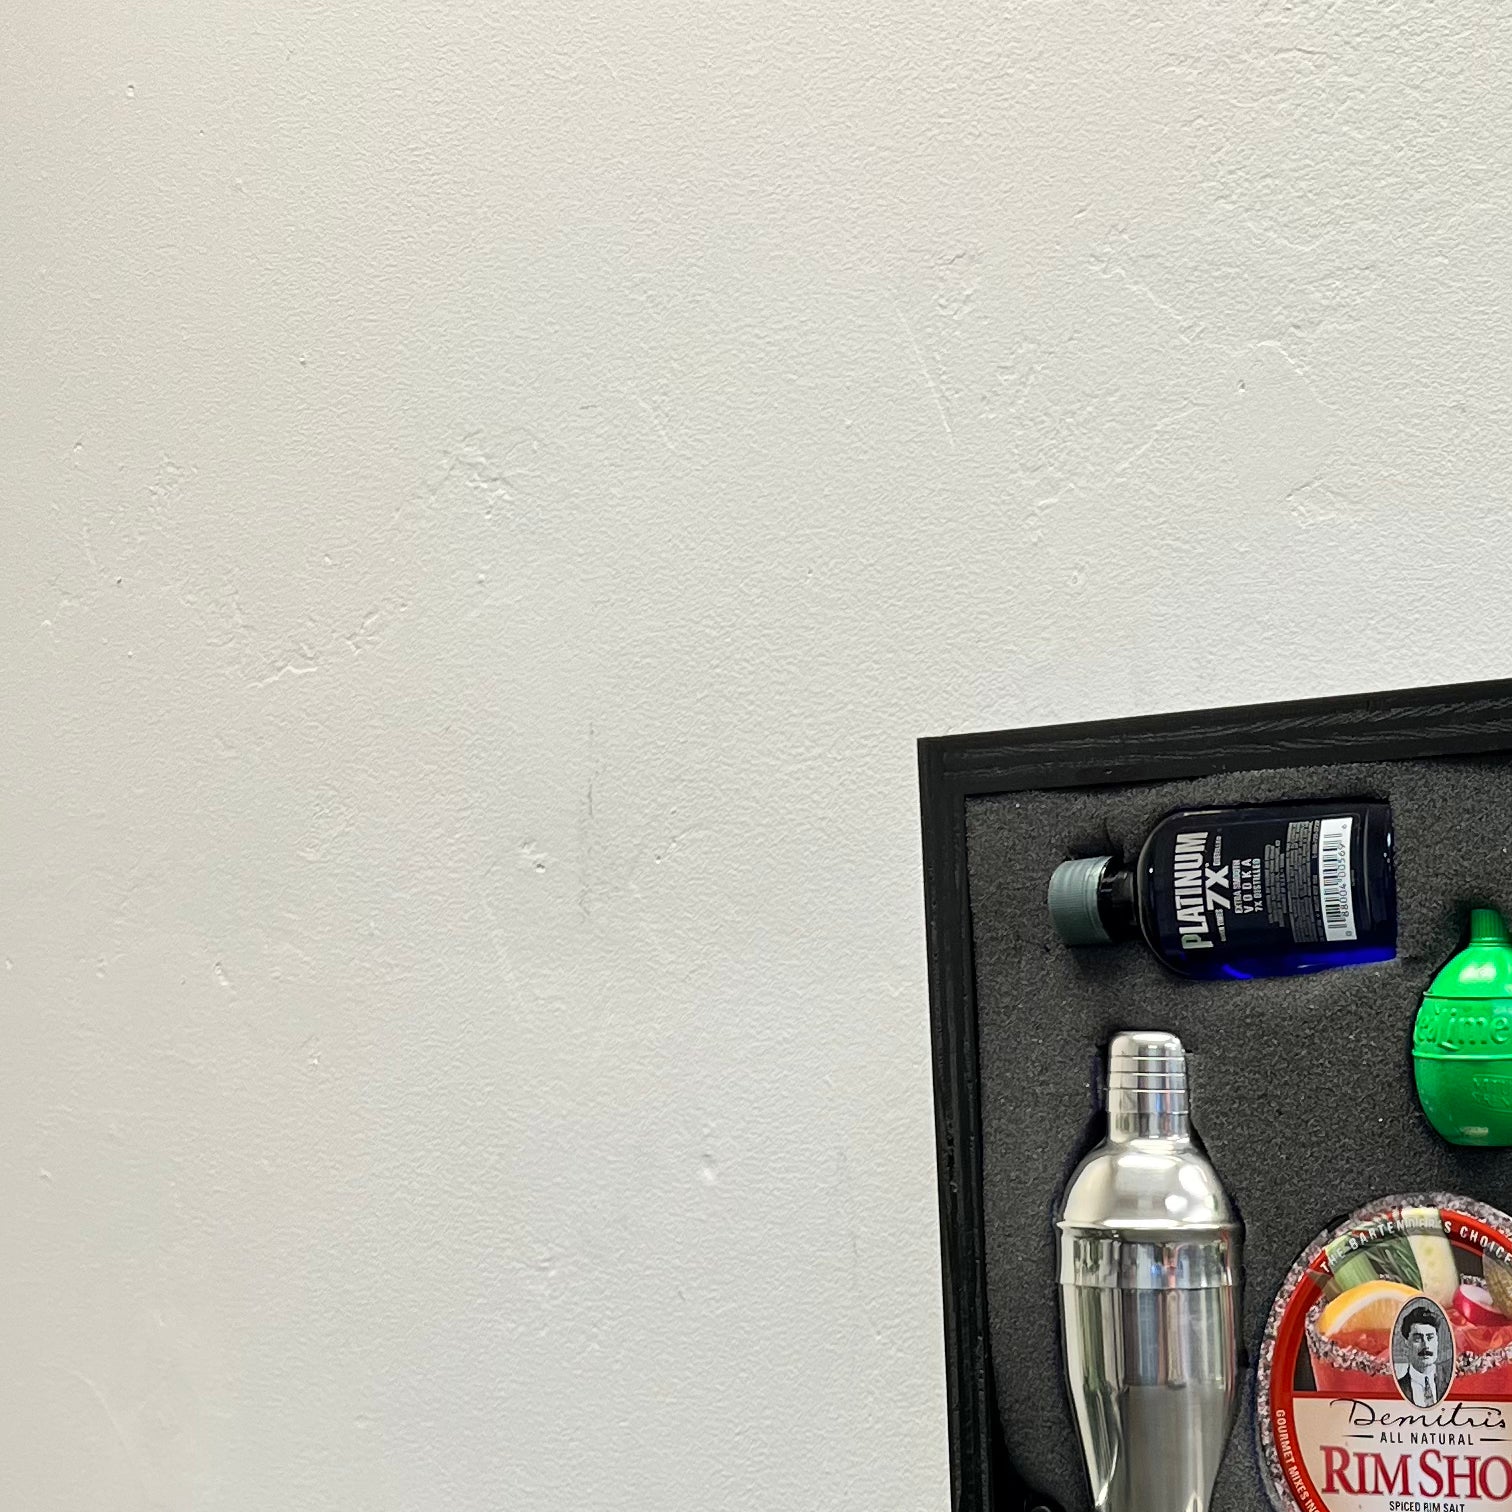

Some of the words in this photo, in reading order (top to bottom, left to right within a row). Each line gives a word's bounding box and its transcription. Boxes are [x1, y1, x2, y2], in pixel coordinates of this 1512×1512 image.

[1174, 832, 1214, 949] PLATINUM
[1205, 863, 1231, 911] 7X
[1241, 858, 1254, 914] VODKA
[1252, 858, 1262, 899] DISTILLED
[1320, 1248, 1346, 1273] THE
[1276, 1409, 1296, 1467] GOURMET
[1288, 1466, 1311, 1501] MIXES
[1380, 1432, 1403, 1444] ALL
[1411, 1433, 1474, 1446] NATURAL
[1390, 1501, 1420, 1512] SPICED
[1424, 1502, 1440, 1512] RIM
